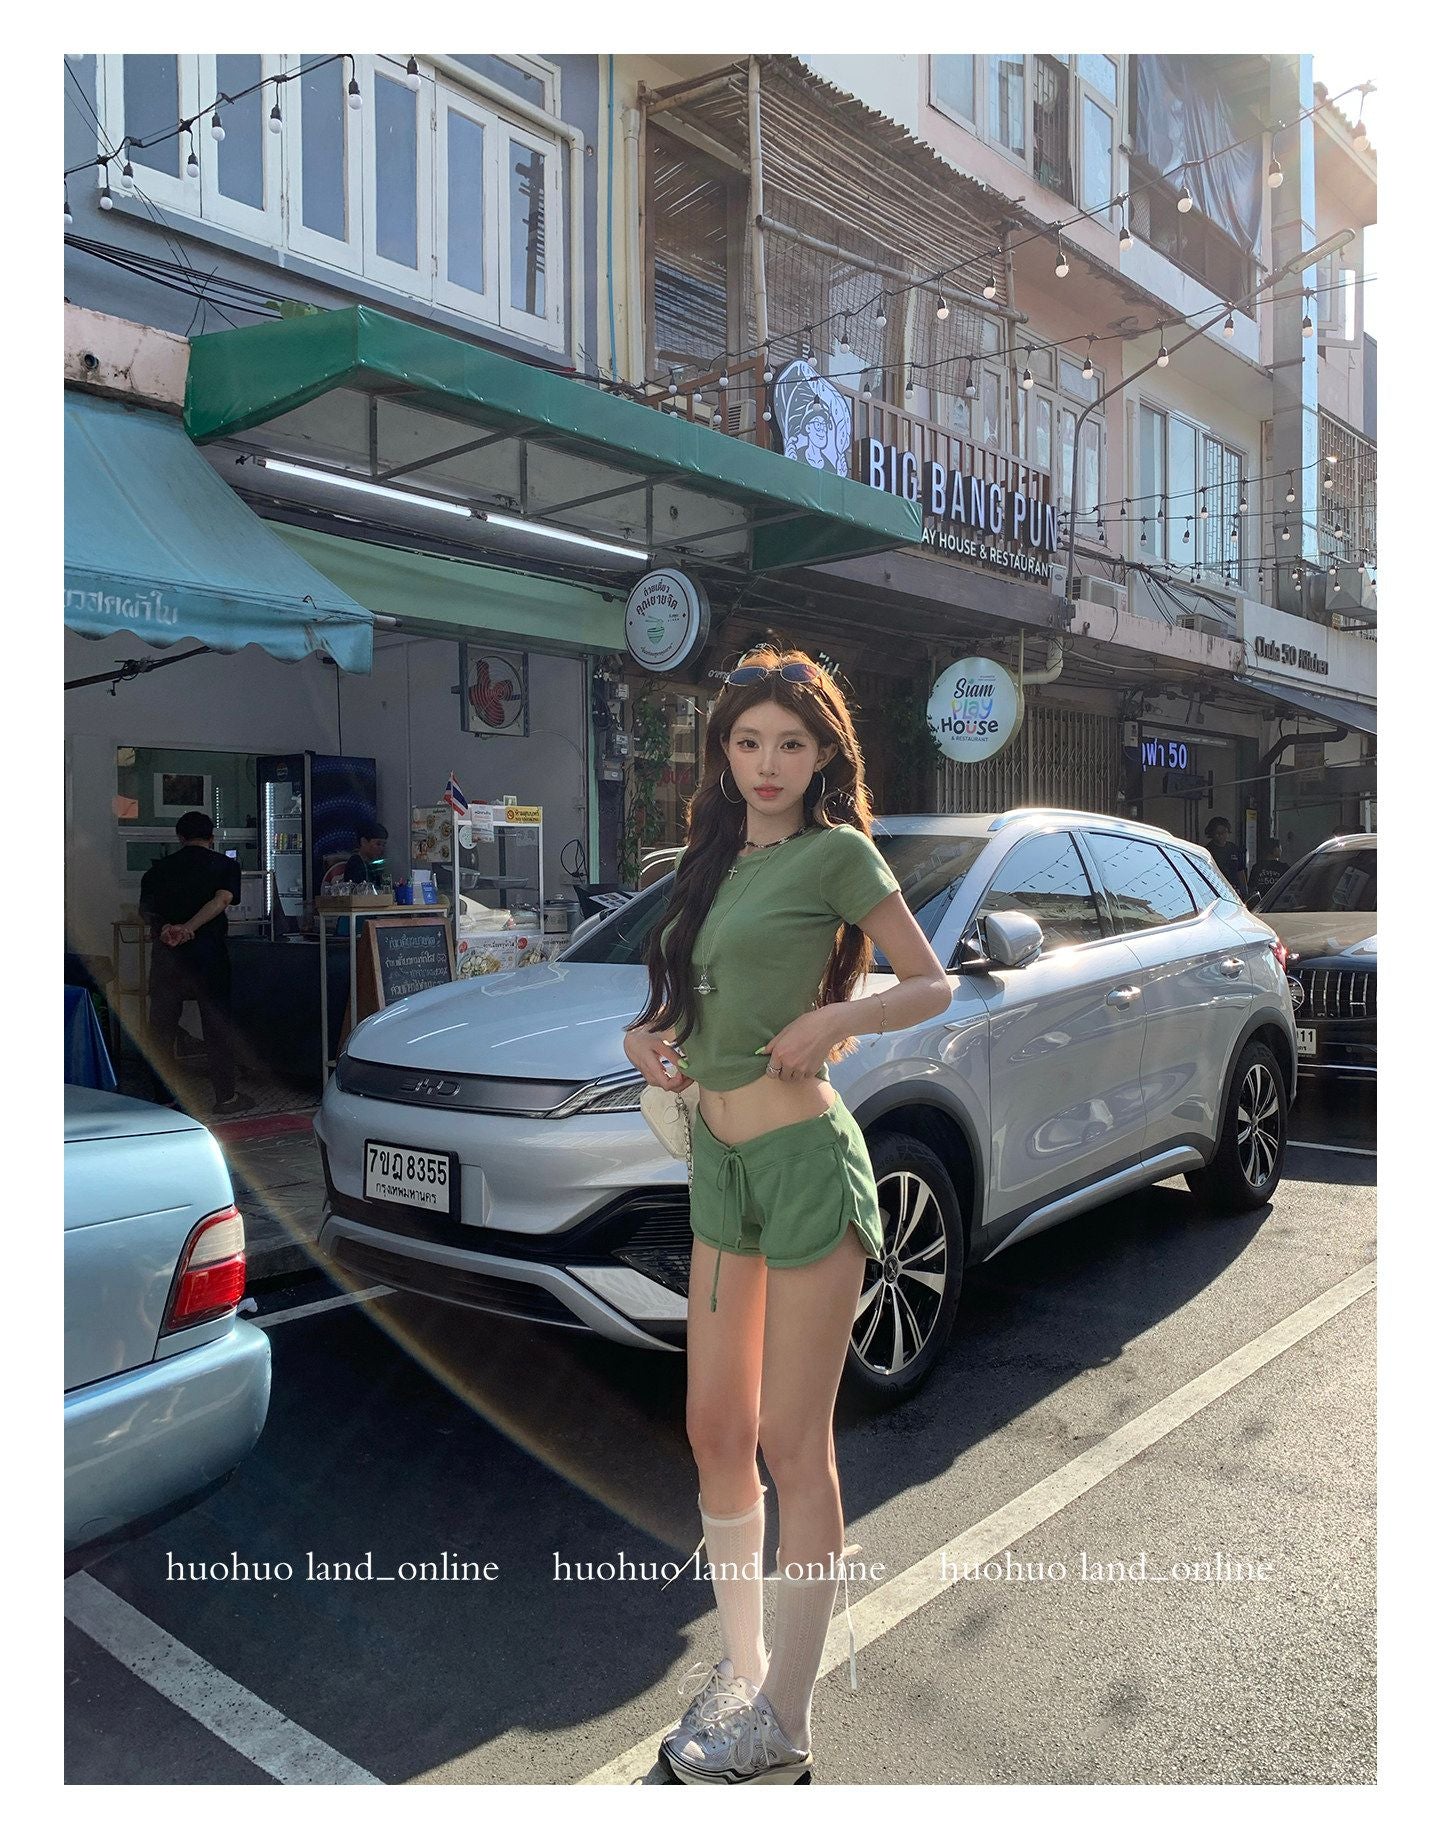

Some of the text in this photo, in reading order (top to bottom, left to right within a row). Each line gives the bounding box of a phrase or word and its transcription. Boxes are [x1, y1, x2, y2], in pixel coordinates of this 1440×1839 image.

[869, 438, 1057, 553] BIG BANG PUN
[939, 534, 976, 557] HOUSE
[979, 544, 988, 560] &
[989, 550, 1054, 580] RESTAURANT
[1281, 643, 1297, 666] 50
[1298, 648, 1329, 676] Kitchen
[954, 677, 995, 698] Siam
[1168, 742, 1188, 770] 50
[1296, 1030, 1313, 1042] 11
[406, 1155, 447, 1186] 8355
[375, 1182, 437, 1204] กรุงเทพมหานคร
